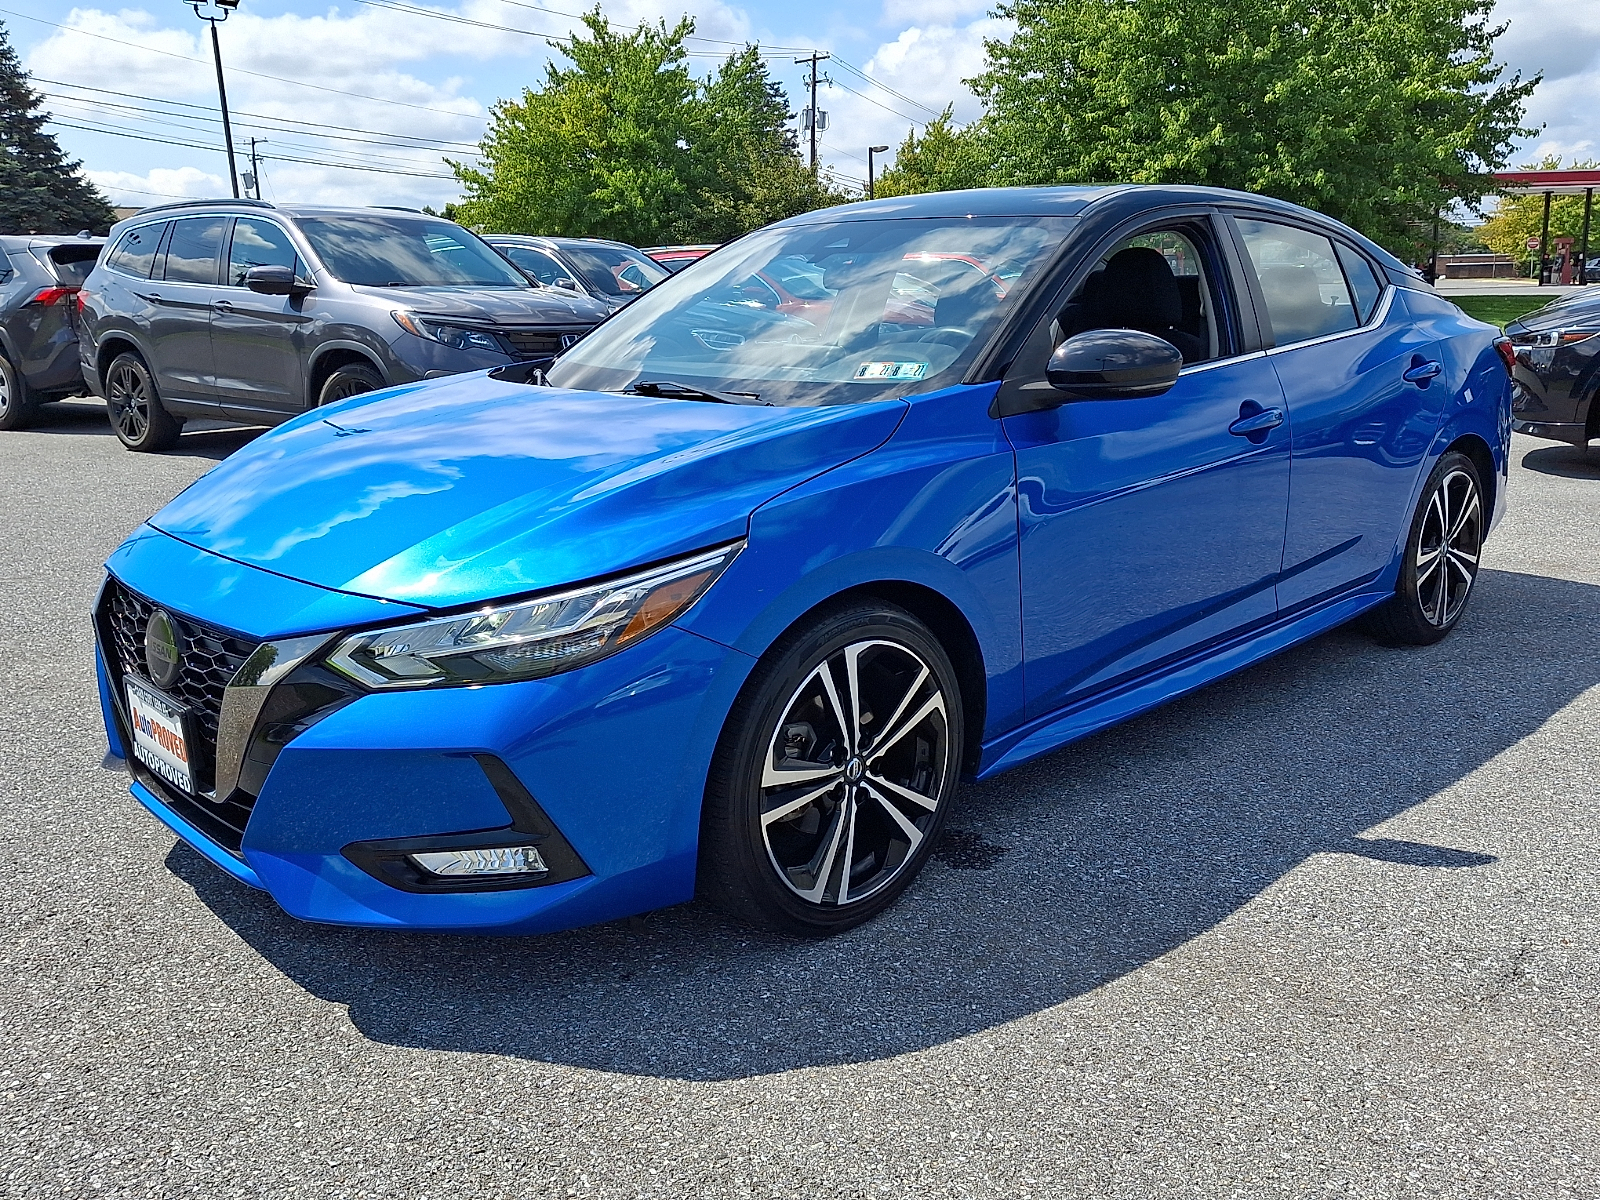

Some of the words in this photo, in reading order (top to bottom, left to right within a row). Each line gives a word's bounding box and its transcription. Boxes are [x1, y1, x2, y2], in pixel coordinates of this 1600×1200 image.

[148, 639, 172, 660] ISSAN
[133, 707, 188, 763] AutoPROVED
[133, 741, 191, 793] AUTOPROVED
